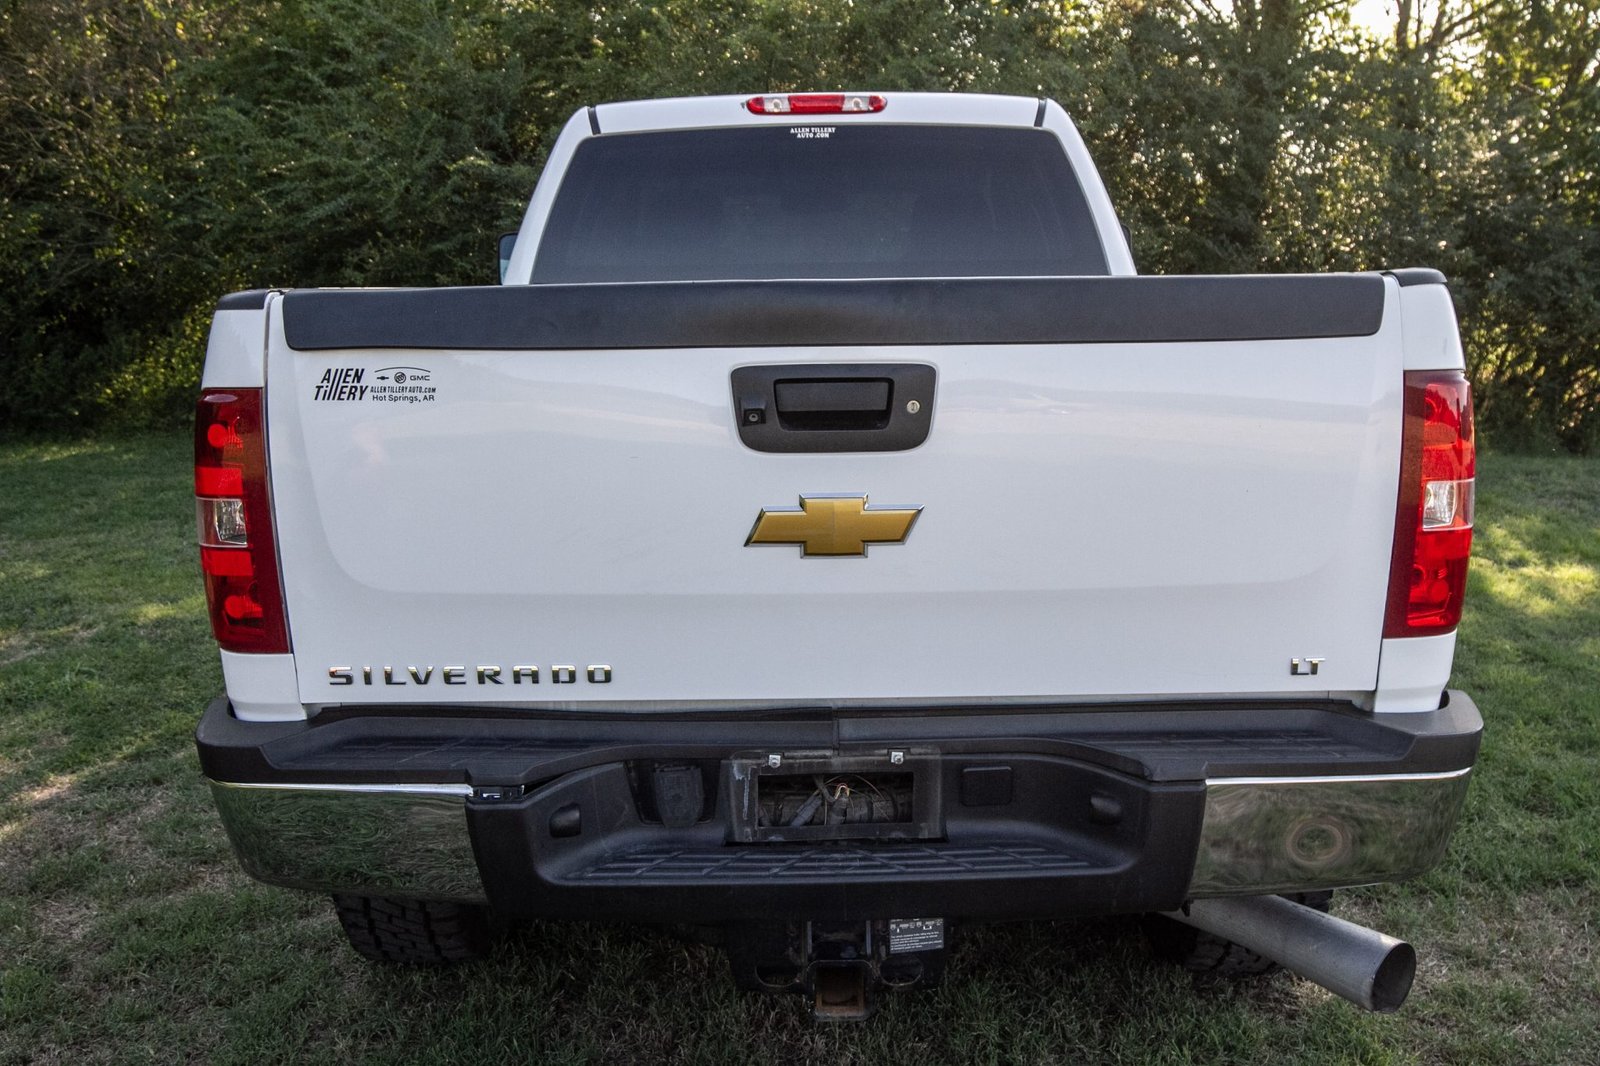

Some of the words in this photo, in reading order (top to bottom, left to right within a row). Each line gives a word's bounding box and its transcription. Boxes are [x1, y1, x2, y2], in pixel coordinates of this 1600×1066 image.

[388, 394, 421, 403] Springs,
[329, 665, 612, 685] SILVERADO
[1291, 657, 1326, 675] LT
